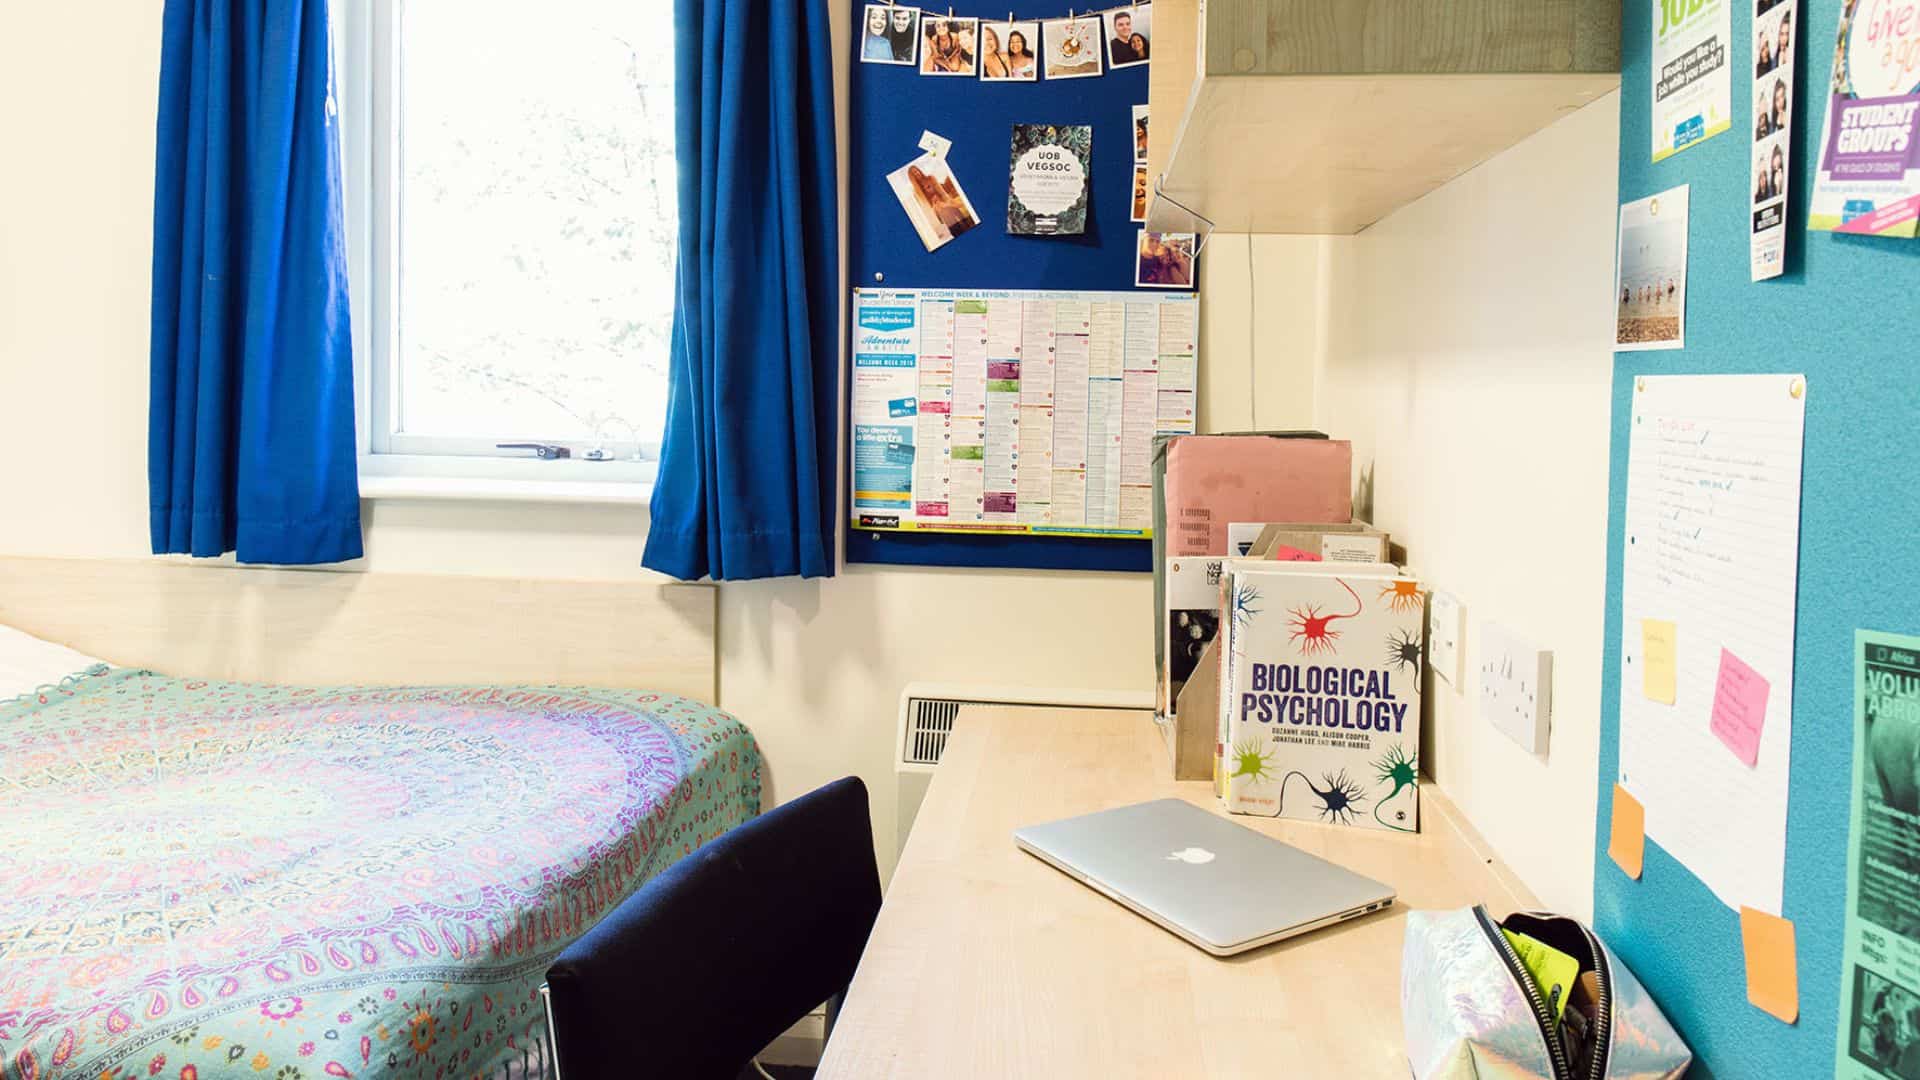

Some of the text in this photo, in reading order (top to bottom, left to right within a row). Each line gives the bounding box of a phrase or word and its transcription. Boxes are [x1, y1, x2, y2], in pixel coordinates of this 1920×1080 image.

[1664, 40, 1716, 80] Would you like a
[1658, 82, 1669, 100] job
[1669, 73, 1685, 90] while
[1685, 66, 1699, 85] you
[1699, 50, 1722, 73] study?
[1841, 102, 1919, 129] STUDENT
[1837, 126, 1912, 154] GROUPS
[1039, 151, 1060, 160] UOB
[1027, 162, 1071, 171] VEGSOC
[860, 336, 911, 345] Adventure
[858, 359, 882, 367] WELCOME
[884, 359, 897, 367] WEEK
[1252, 663, 1396, 700] BIOLOGICAL
[1241, 693, 1408, 733] PSYCHOLOGY
[1272, 736, 1303, 744] JONATHAN
[1331, 740, 1346, 748] MIKE
[1347, 742, 1371, 750] HARRIS
[1322, 731, 1344, 739] ALISON
